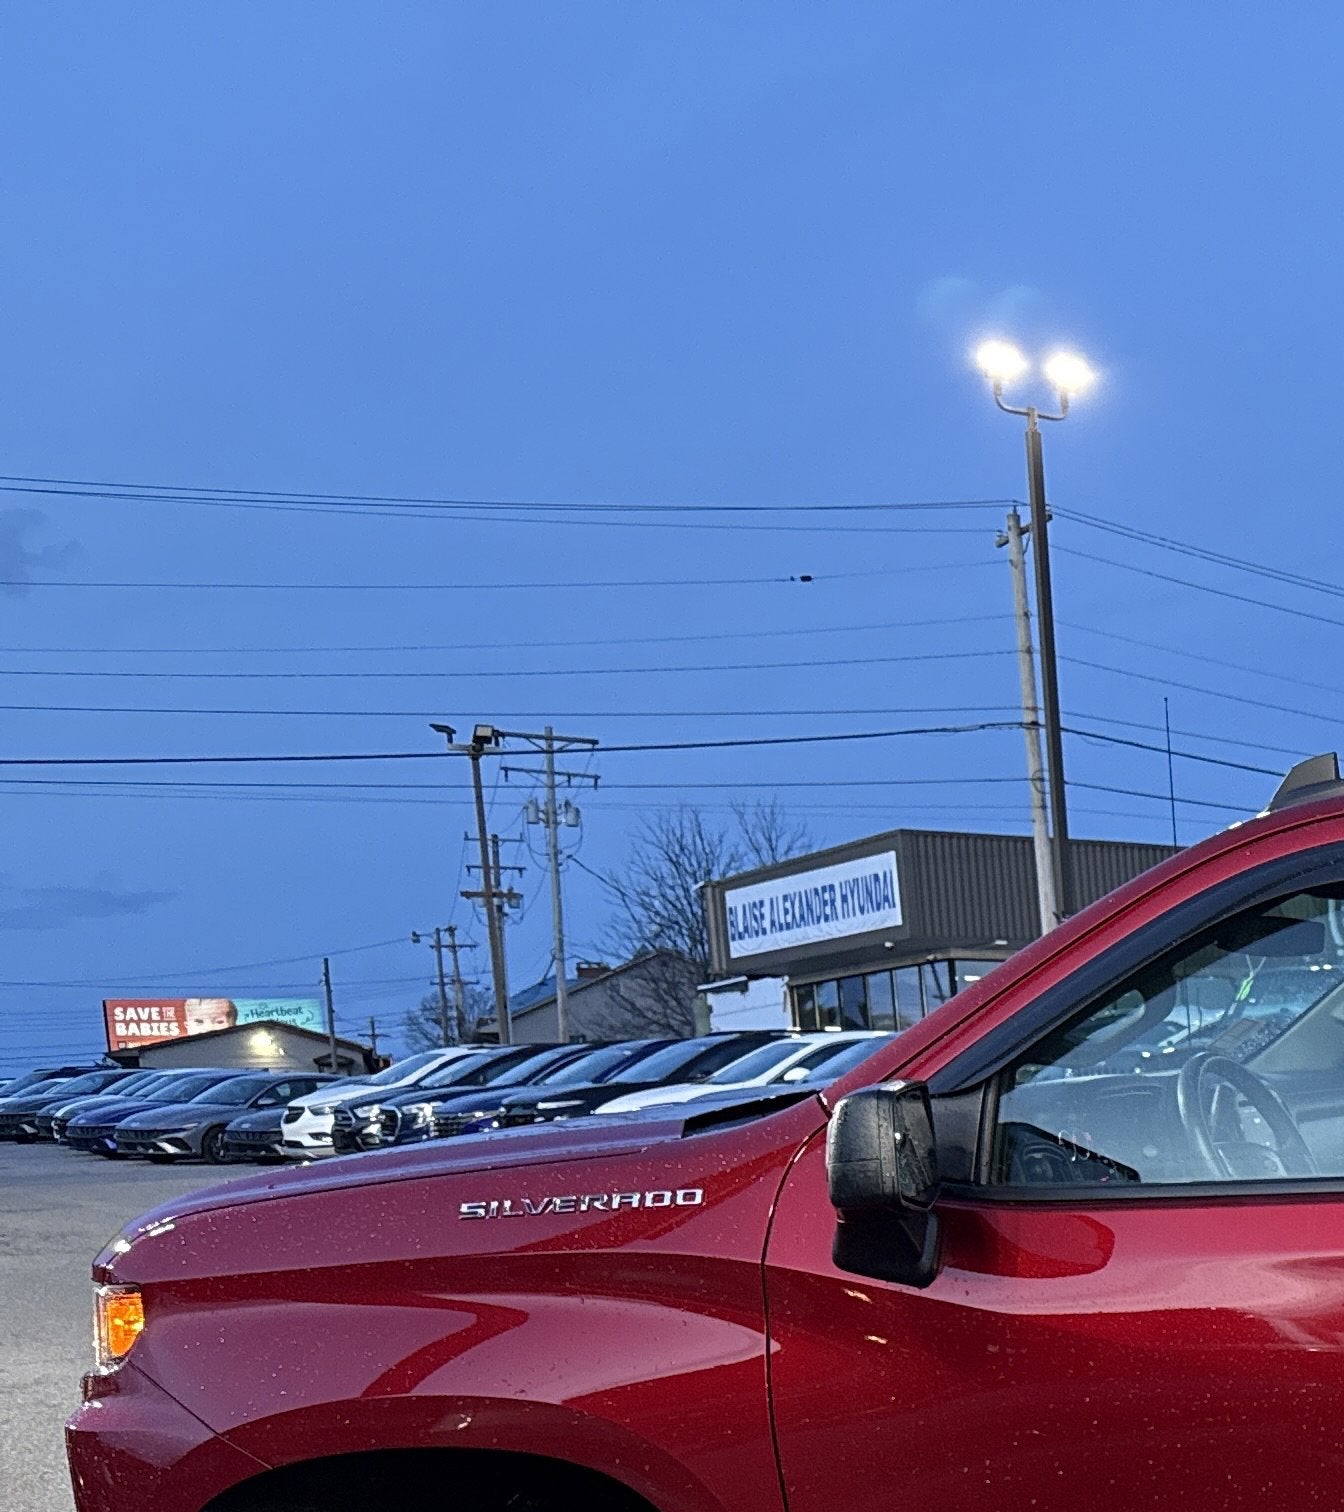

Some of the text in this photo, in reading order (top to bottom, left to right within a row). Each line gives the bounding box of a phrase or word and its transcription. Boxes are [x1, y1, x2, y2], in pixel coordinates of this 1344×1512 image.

[728, 869, 897, 942] BLAISE ALEXANDER HYUNDAI
[113, 1006, 161, 1021] SAVE
[250, 1006, 303, 1019] Heartbeat
[115, 1022, 181, 1037] BABIES
[459, 1188, 704, 1220] SILVERADO
